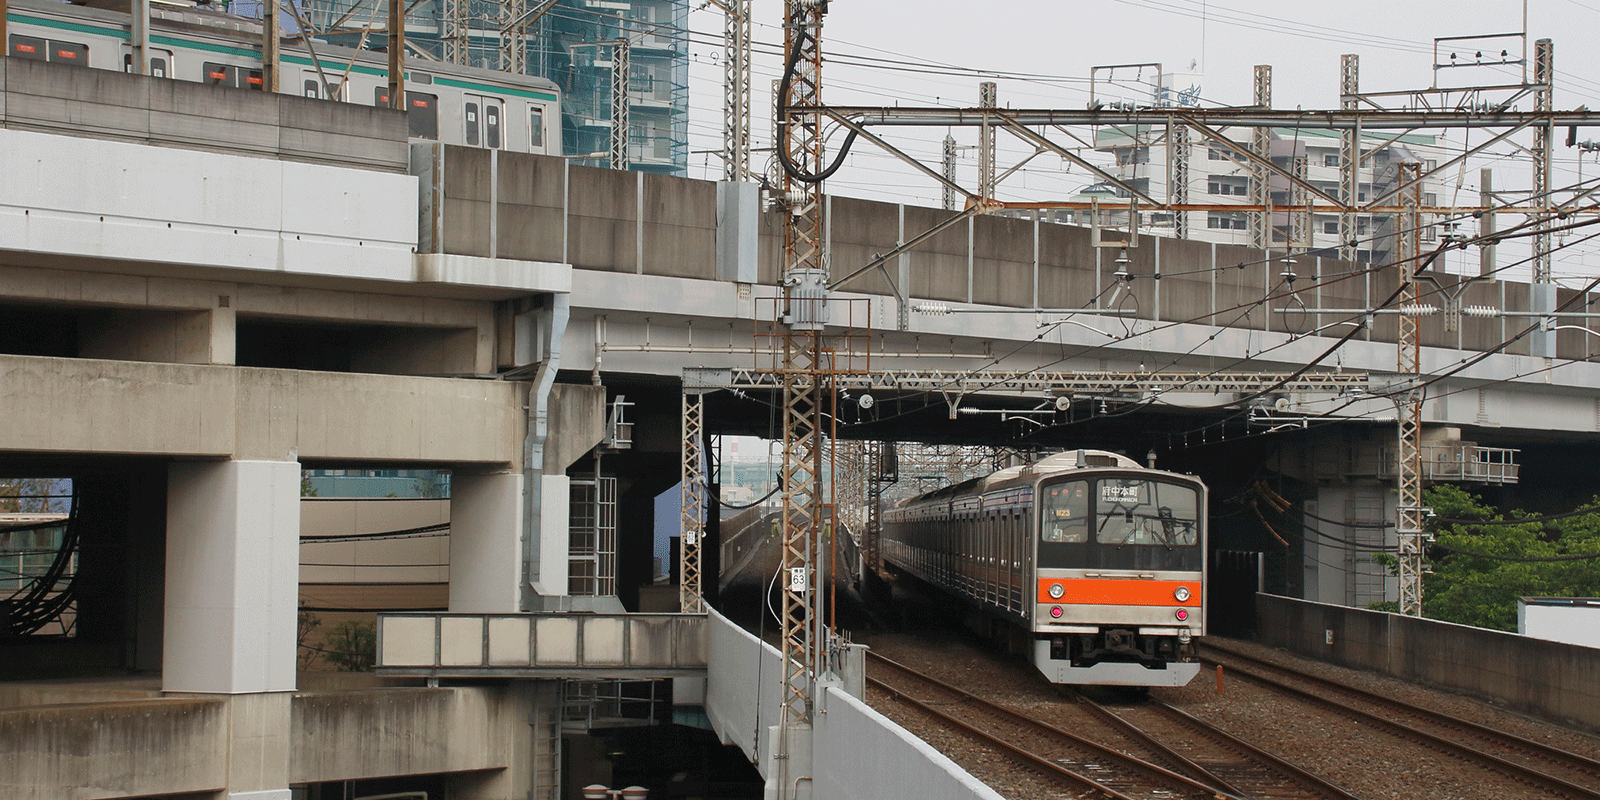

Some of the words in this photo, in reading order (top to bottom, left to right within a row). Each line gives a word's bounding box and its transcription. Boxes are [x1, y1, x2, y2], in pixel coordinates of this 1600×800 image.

[1102, 486, 1138, 497] 府中本町
[793, 575, 805, 585] 63
